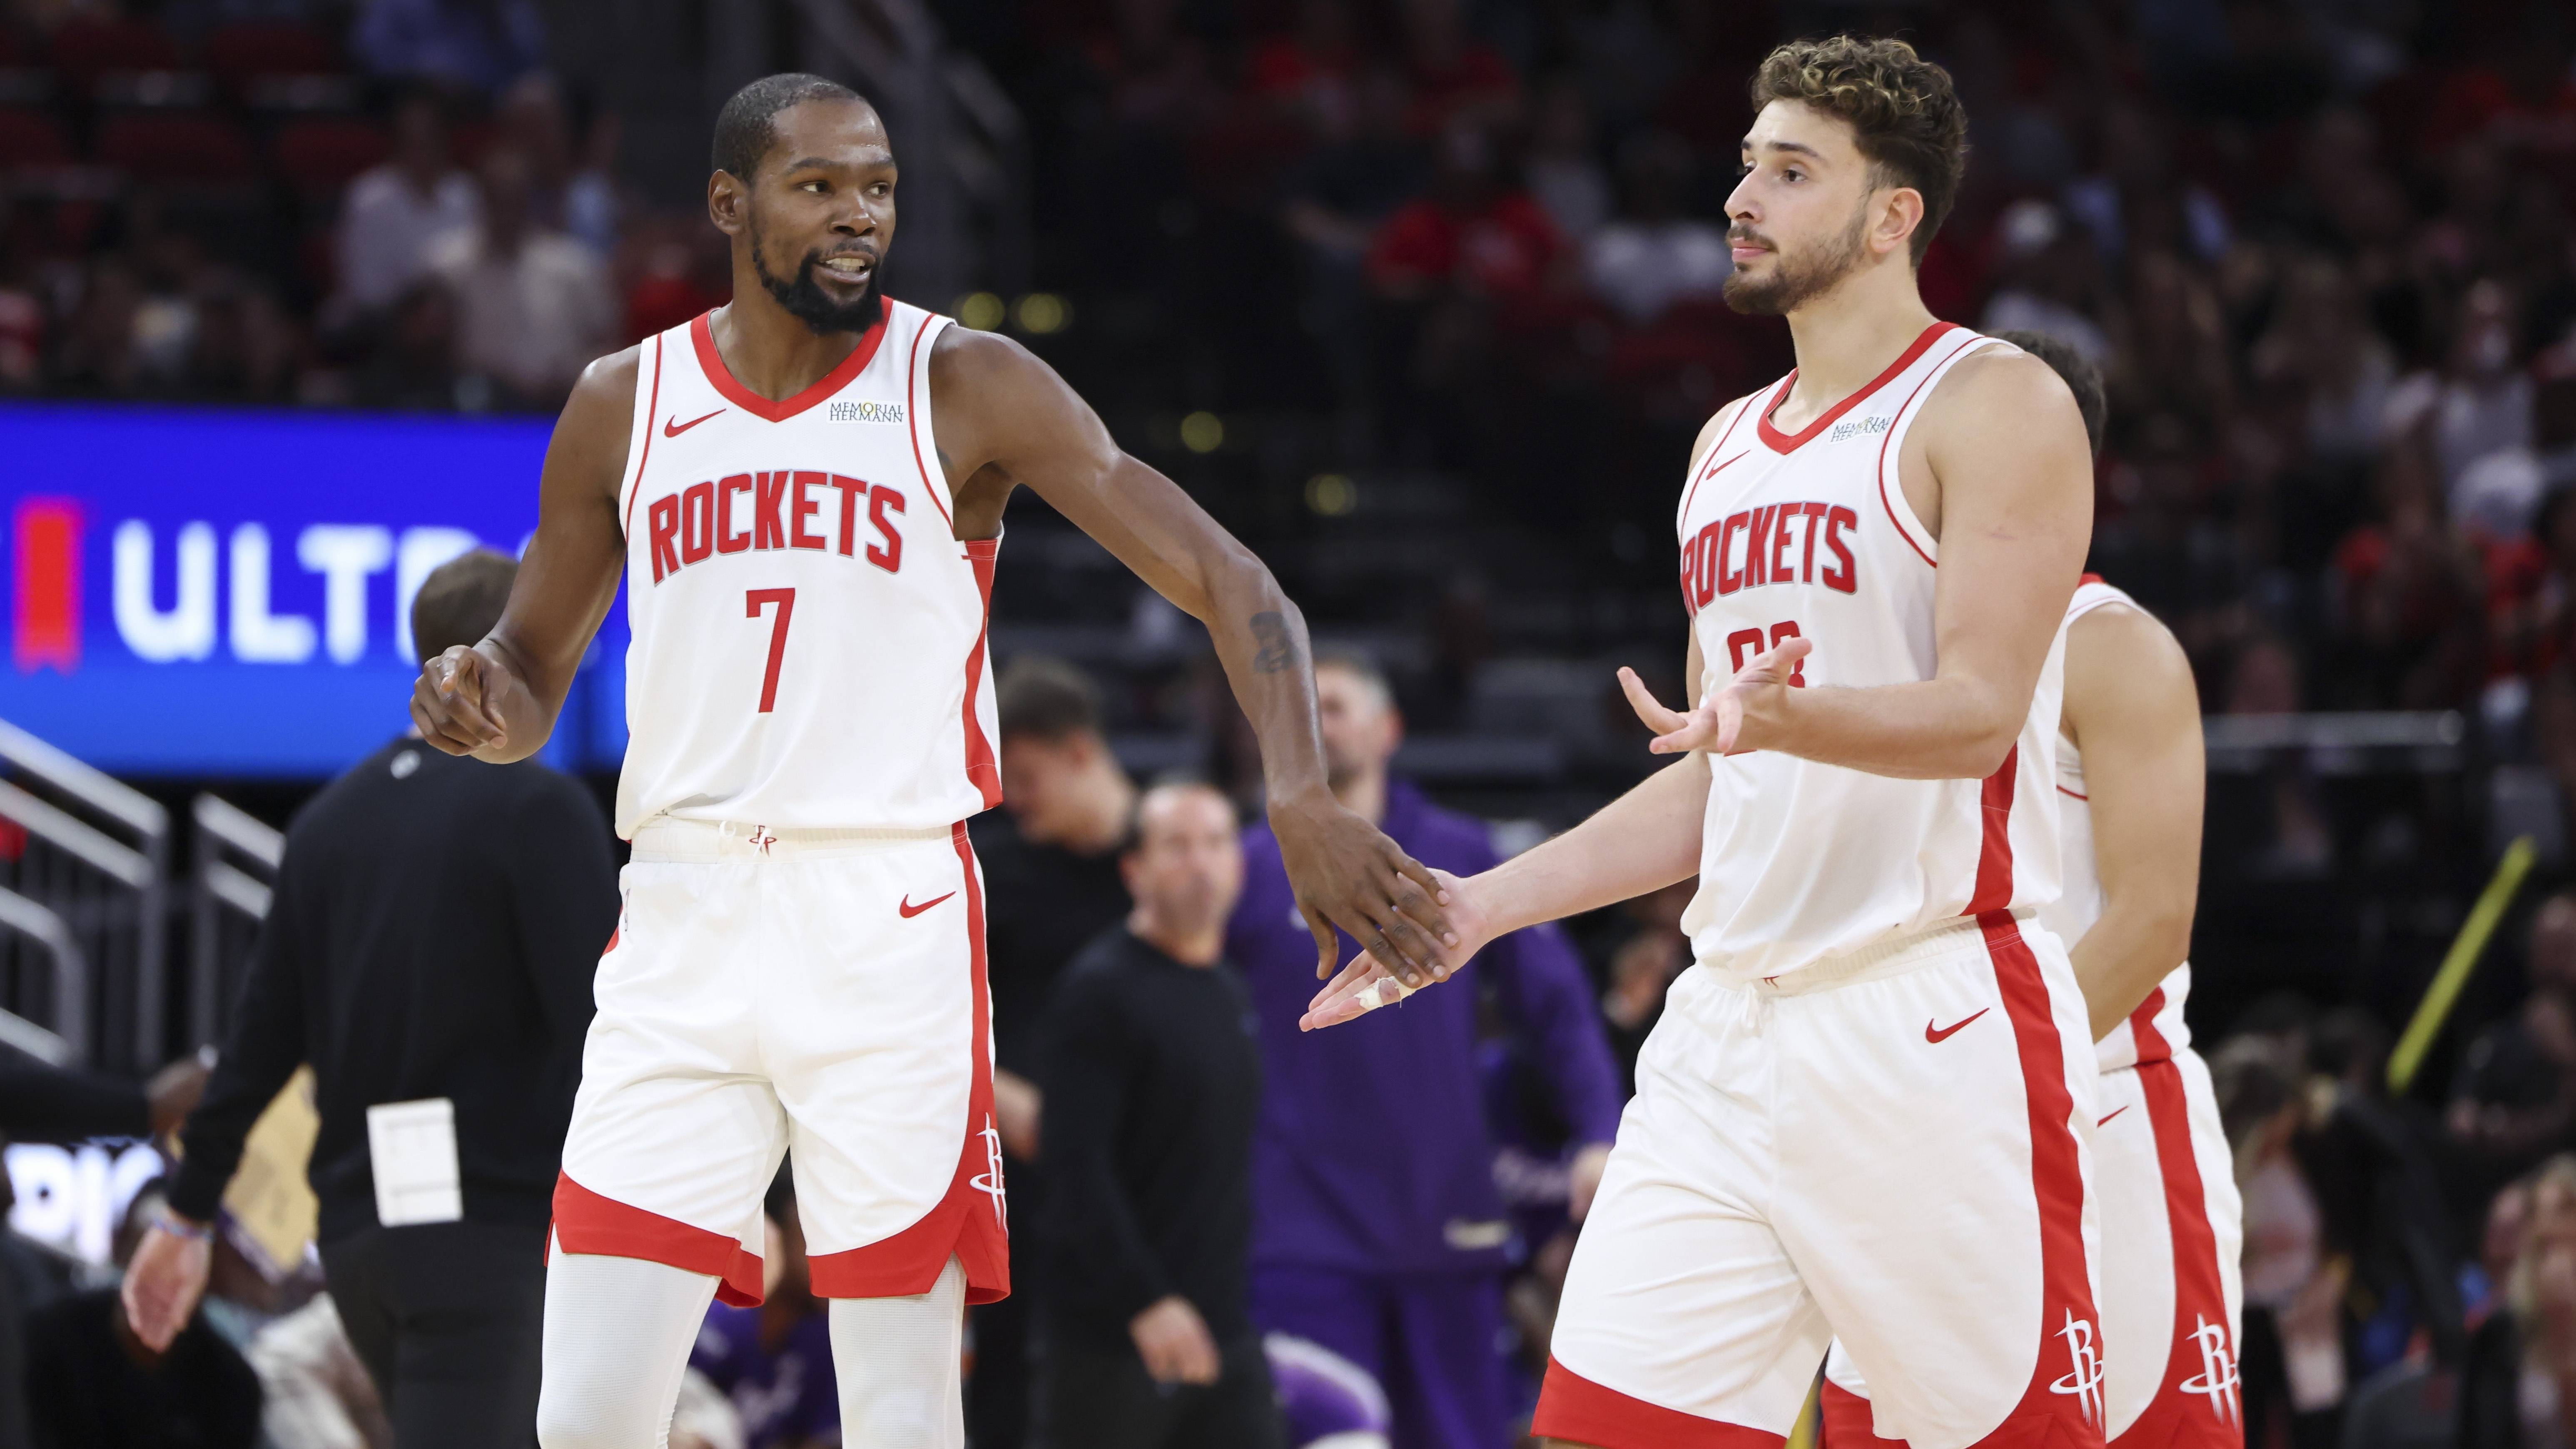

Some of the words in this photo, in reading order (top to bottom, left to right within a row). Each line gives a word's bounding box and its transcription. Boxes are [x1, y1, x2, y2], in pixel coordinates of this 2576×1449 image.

[830, 402, 904, 415] MEMORIAL
[830, 411, 904, 423] HERMANN
[648, 469, 906, 587] ROCKETS
[1680, 500, 1858, 623] ROCKETS
[112, 517, 539, 665] ULT
[746, 587, 796, 713] 7
